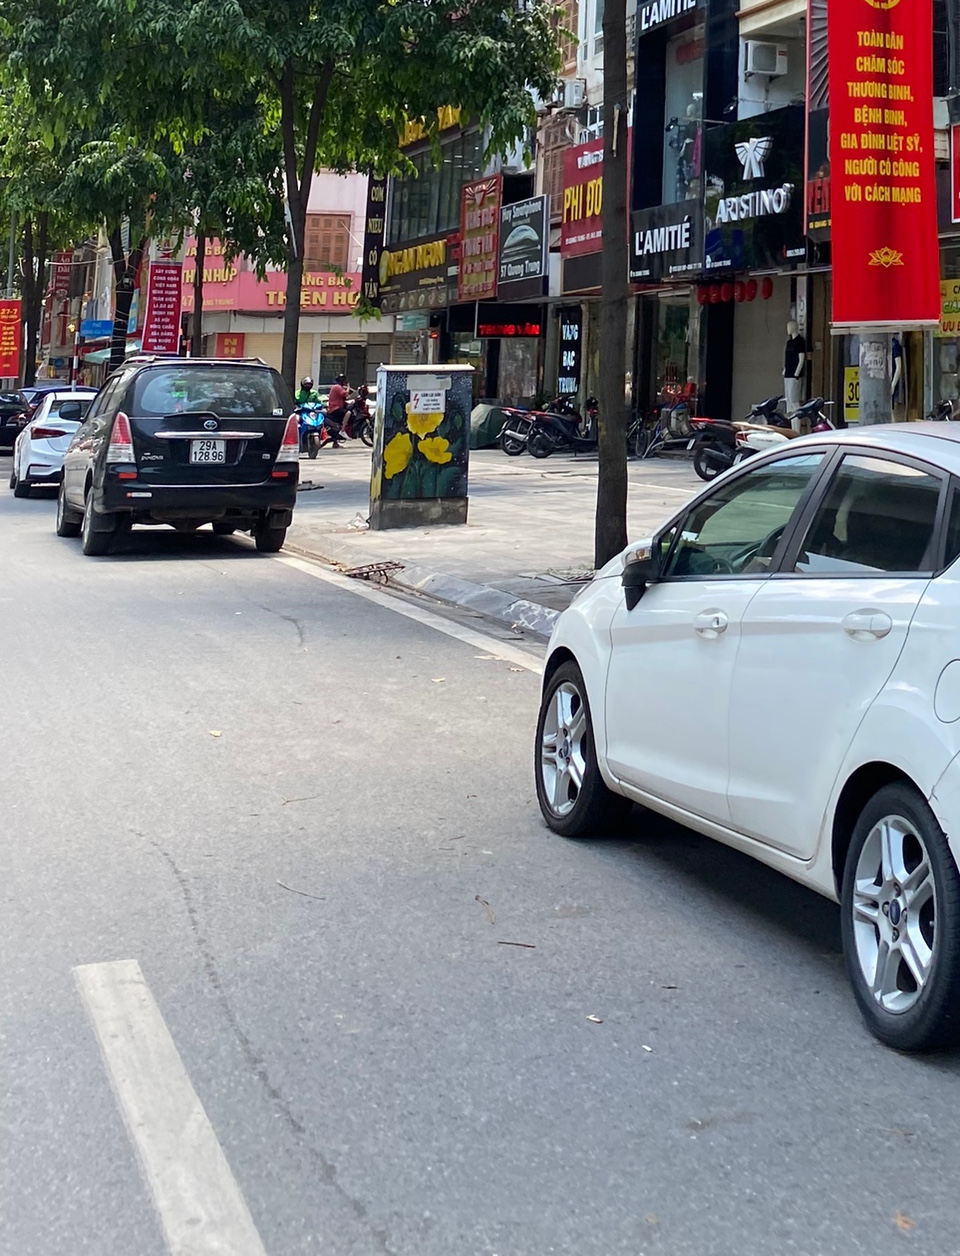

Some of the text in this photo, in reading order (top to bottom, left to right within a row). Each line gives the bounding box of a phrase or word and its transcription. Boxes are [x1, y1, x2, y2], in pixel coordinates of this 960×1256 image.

[857, 28, 904, 50] TOÀN DÂN
[856, 54, 905, 75] CHĂM SÓC
[847, 80, 914, 102] THƯƠNG BINH,
[854, 104, 908, 127] BỆNH BINH,
[840, 132, 859, 149] GIA
[860, 130, 885, 150] ĐÌNH
[906, 133, 923, 153] SỸ,
[844, 155, 920, 177] NGƯỜI CÓ CÔNG
[844, 182, 862, 201] VỚI
[864, 182, 891, 201] CÁCH
[891, 186, 922, 206] MẠNG
[715, 187, 787, 224] ARISTINO
[634, 214, 691, 257] L'AMITIÉ
[193, 451, 223, 461] 128.96
[199, 441, 217, 451] 29A
